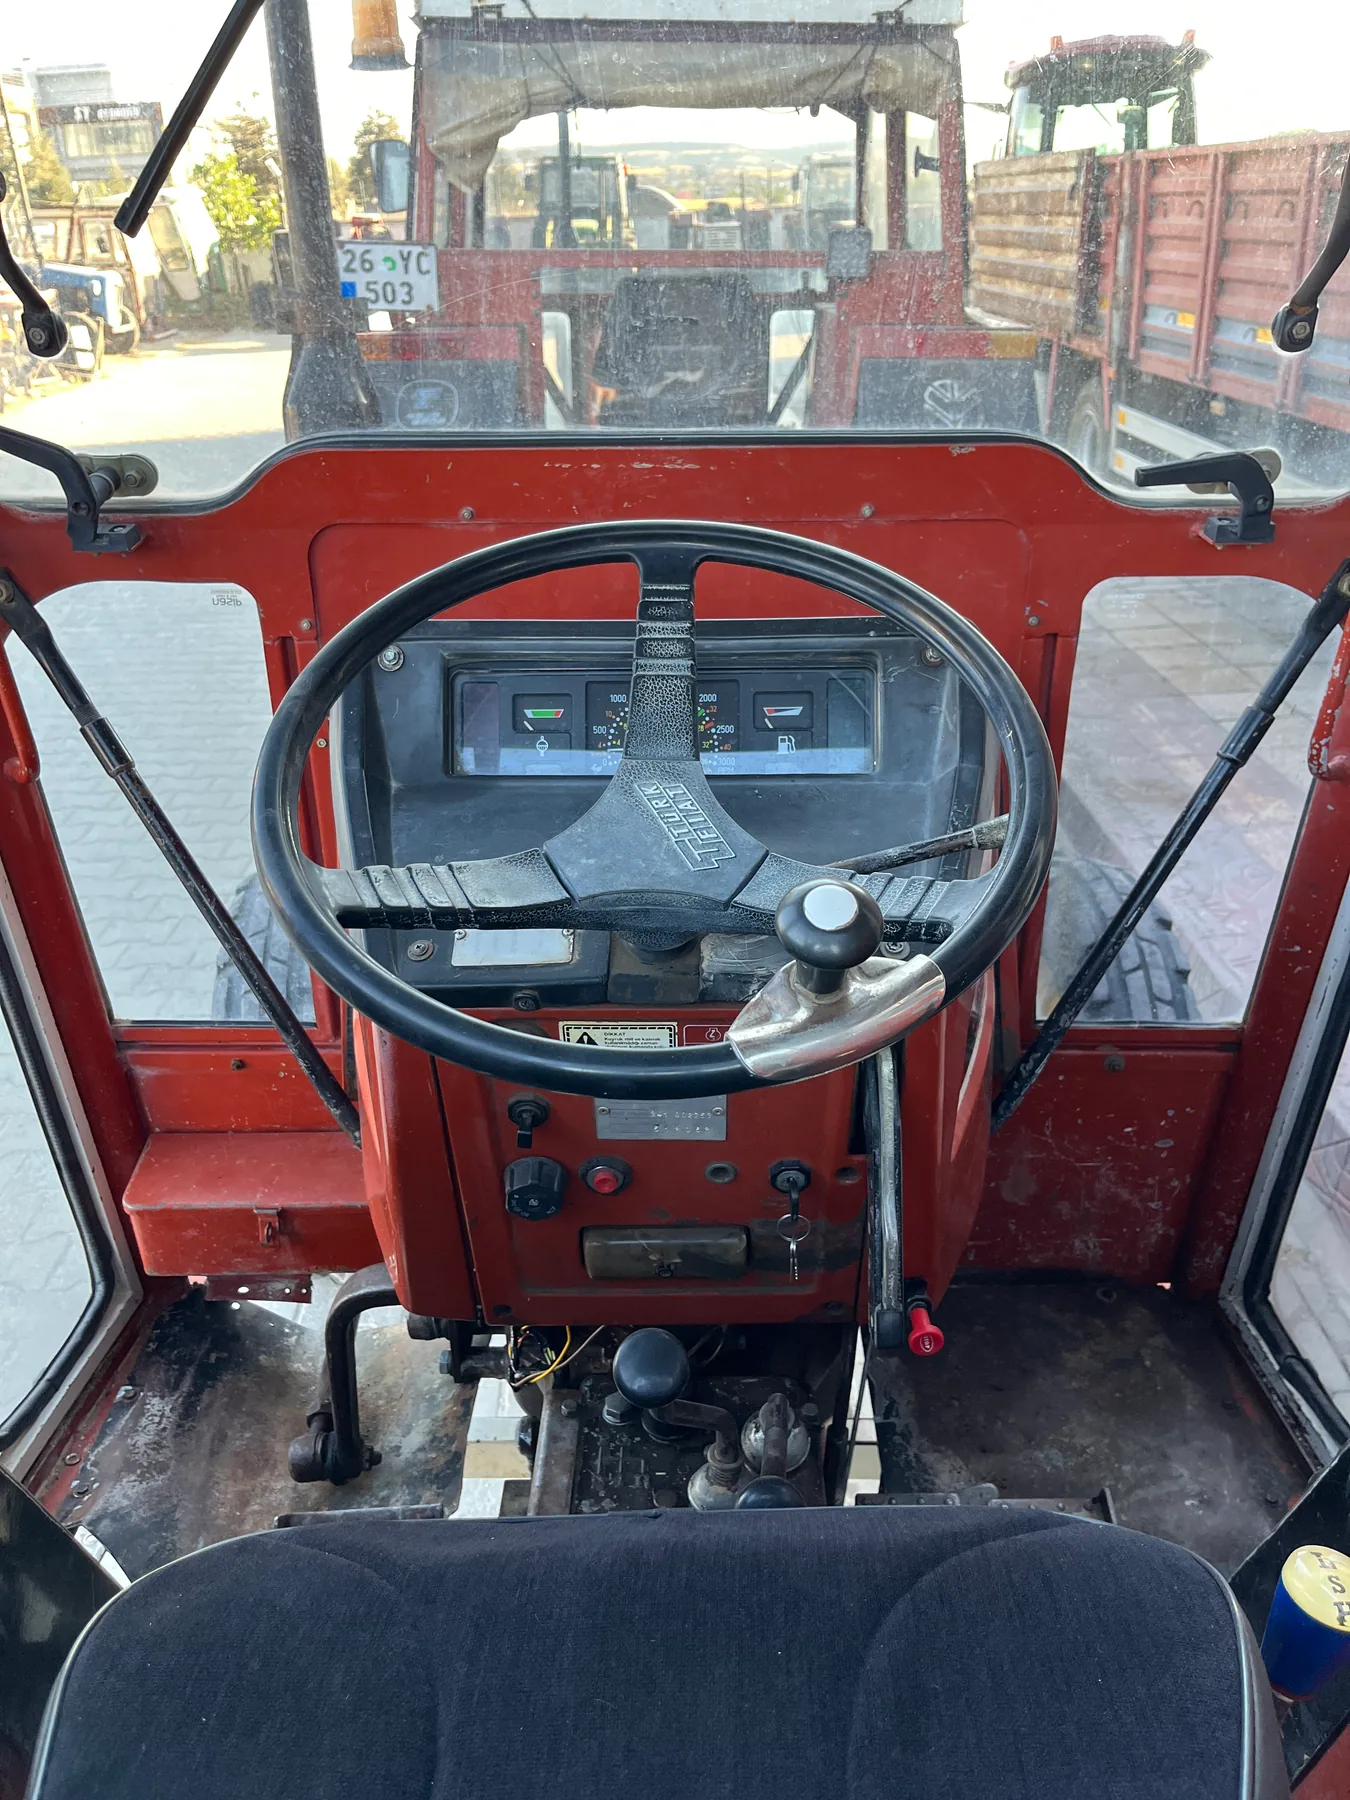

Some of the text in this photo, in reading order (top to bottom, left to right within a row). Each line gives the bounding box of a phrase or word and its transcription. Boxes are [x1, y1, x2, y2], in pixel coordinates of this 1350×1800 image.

[342, 248, 431, 275] 26 YC
[364, 279, 414, 305] 503
[610, 694, 627, 703] 1000
[699, 693, 717, 702] 2000
[592, 725, 607, 734] 500
[716, 724, 735, 733] 2500
[717, 757, 736, 765] 3000
[1327, 1575, 1346, 1594] S
